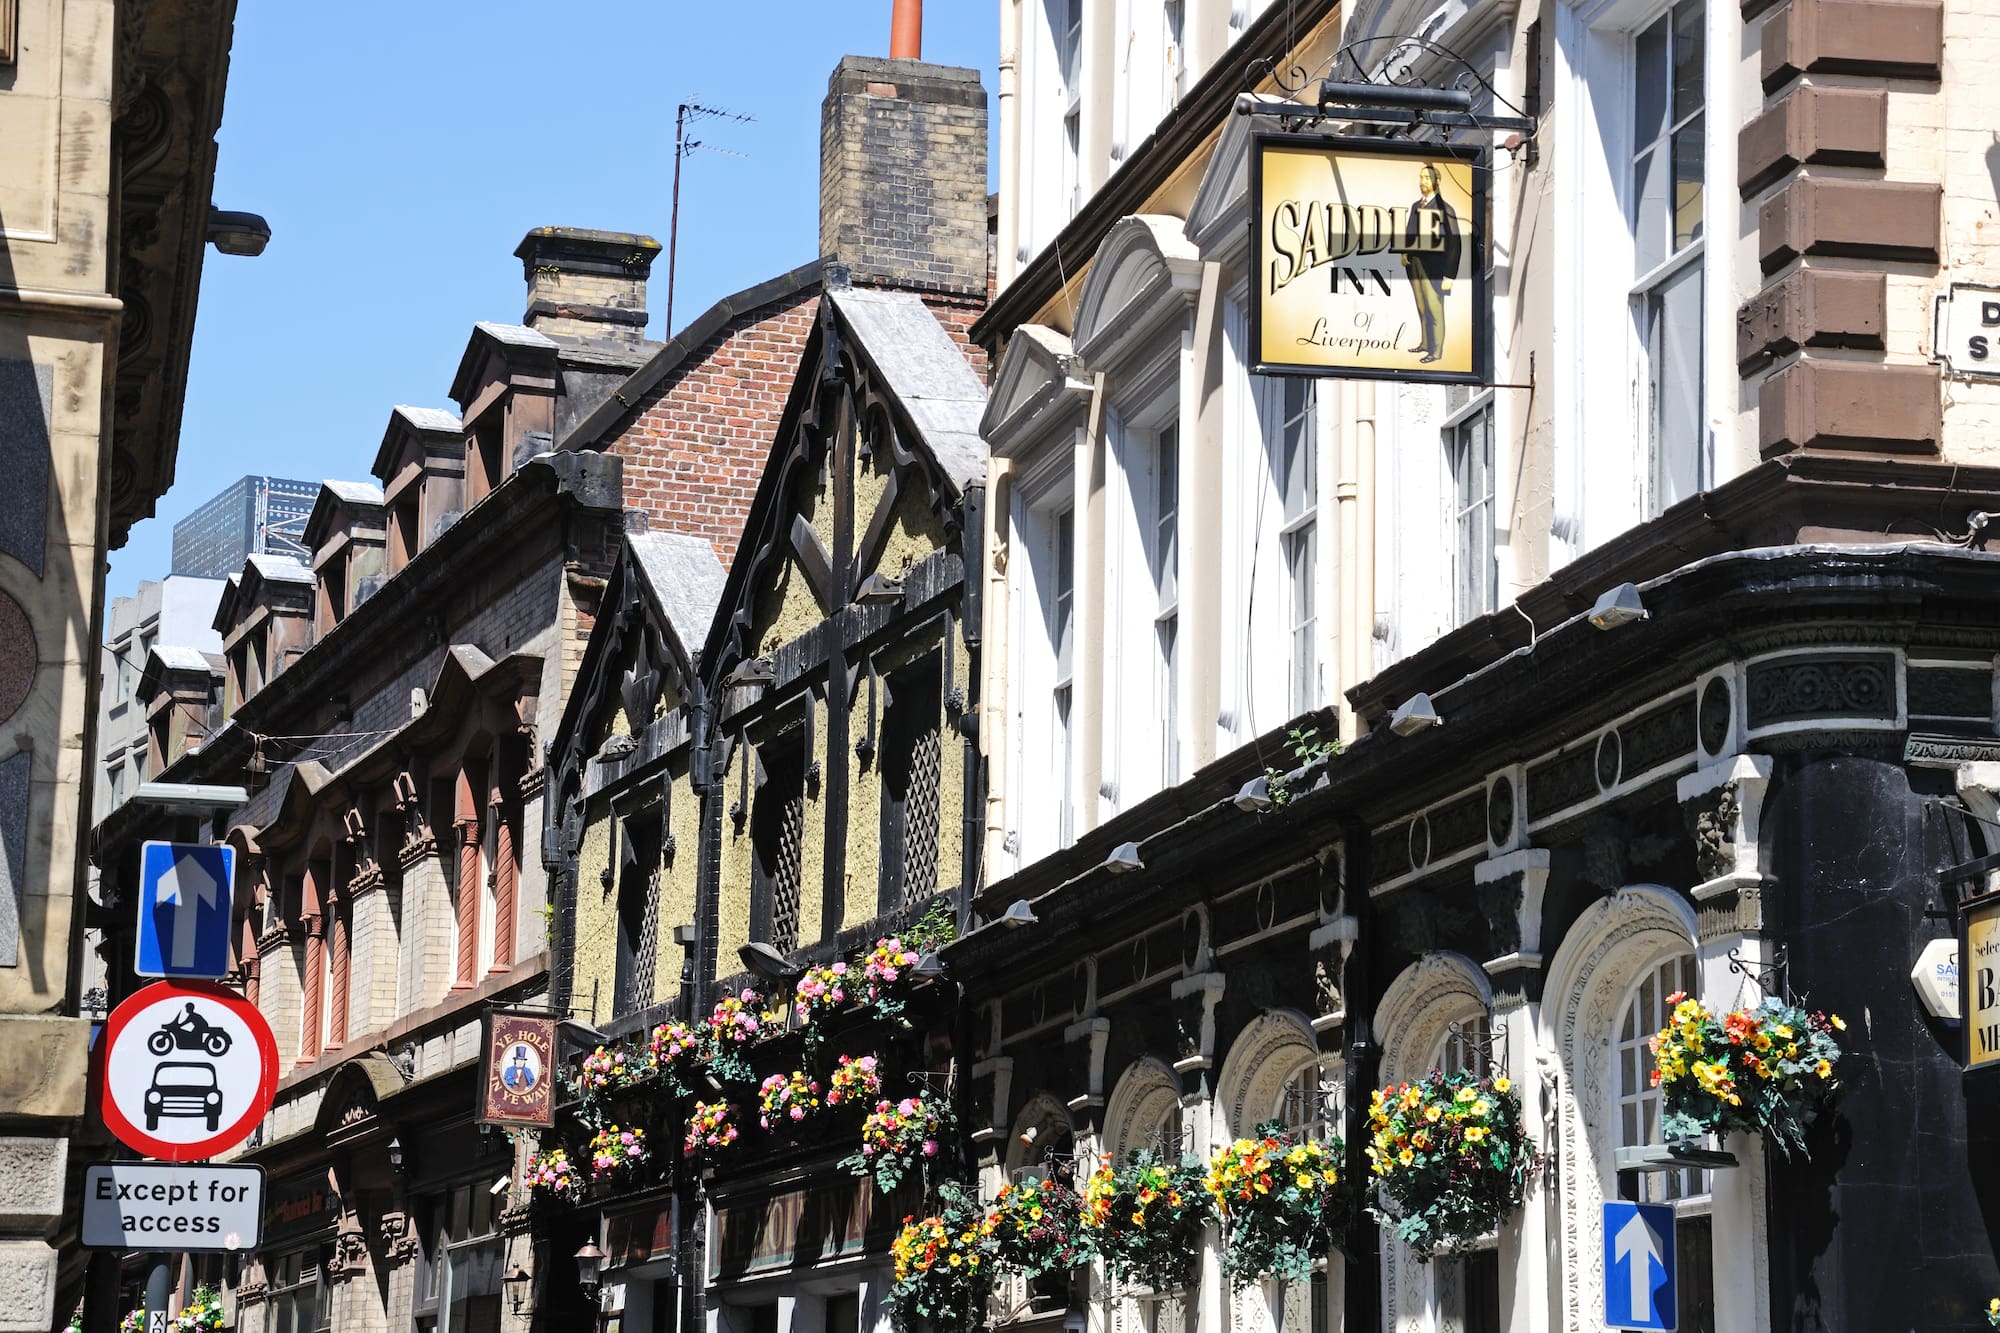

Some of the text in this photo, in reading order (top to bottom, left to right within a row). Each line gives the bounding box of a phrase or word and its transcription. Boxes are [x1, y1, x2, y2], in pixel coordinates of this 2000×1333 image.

[1271, 200, 1446, 296] SADDLE
[1330, 267, 1393, 296] INN
[1353, 311, 1375, 331] Of
[1296, 316, 1407, 356] Liverpool
[496, 1030, 549, 1052] YE HOLE
[491, 1076, 551, 1105] IN YE WALL
[96, 1177, 249, 1205] Except for
[121, 1214, 220, 1233] access
